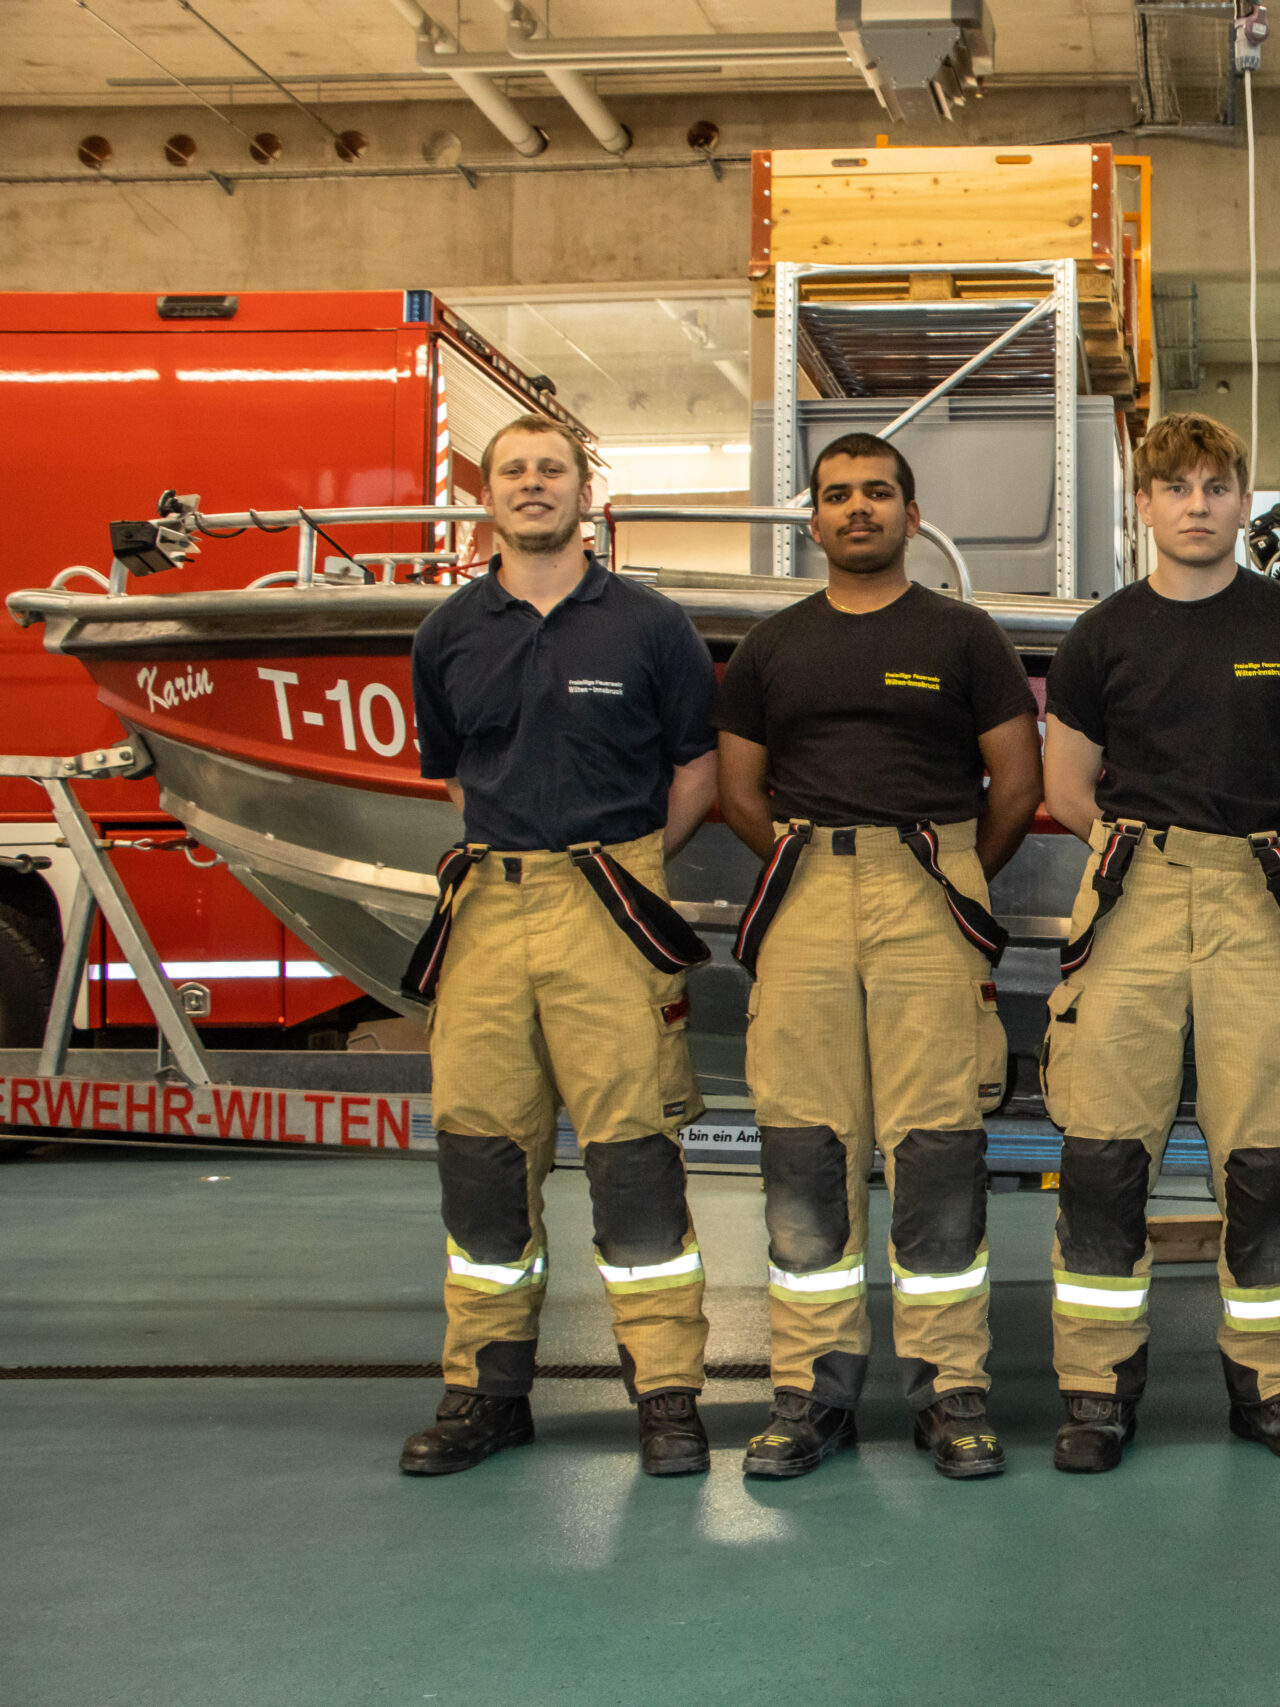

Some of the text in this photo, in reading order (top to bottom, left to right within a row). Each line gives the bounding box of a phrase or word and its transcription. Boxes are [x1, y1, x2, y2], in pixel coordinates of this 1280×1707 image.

[137, 665, 213, 713] Karin
[257, 666, 421, 757] T-10
[0, 1076, 411, 1150] RWEHR-WILTEN
[688, 1128, 709, 1143] bin
[712, 1130, 732, 1143] ein
